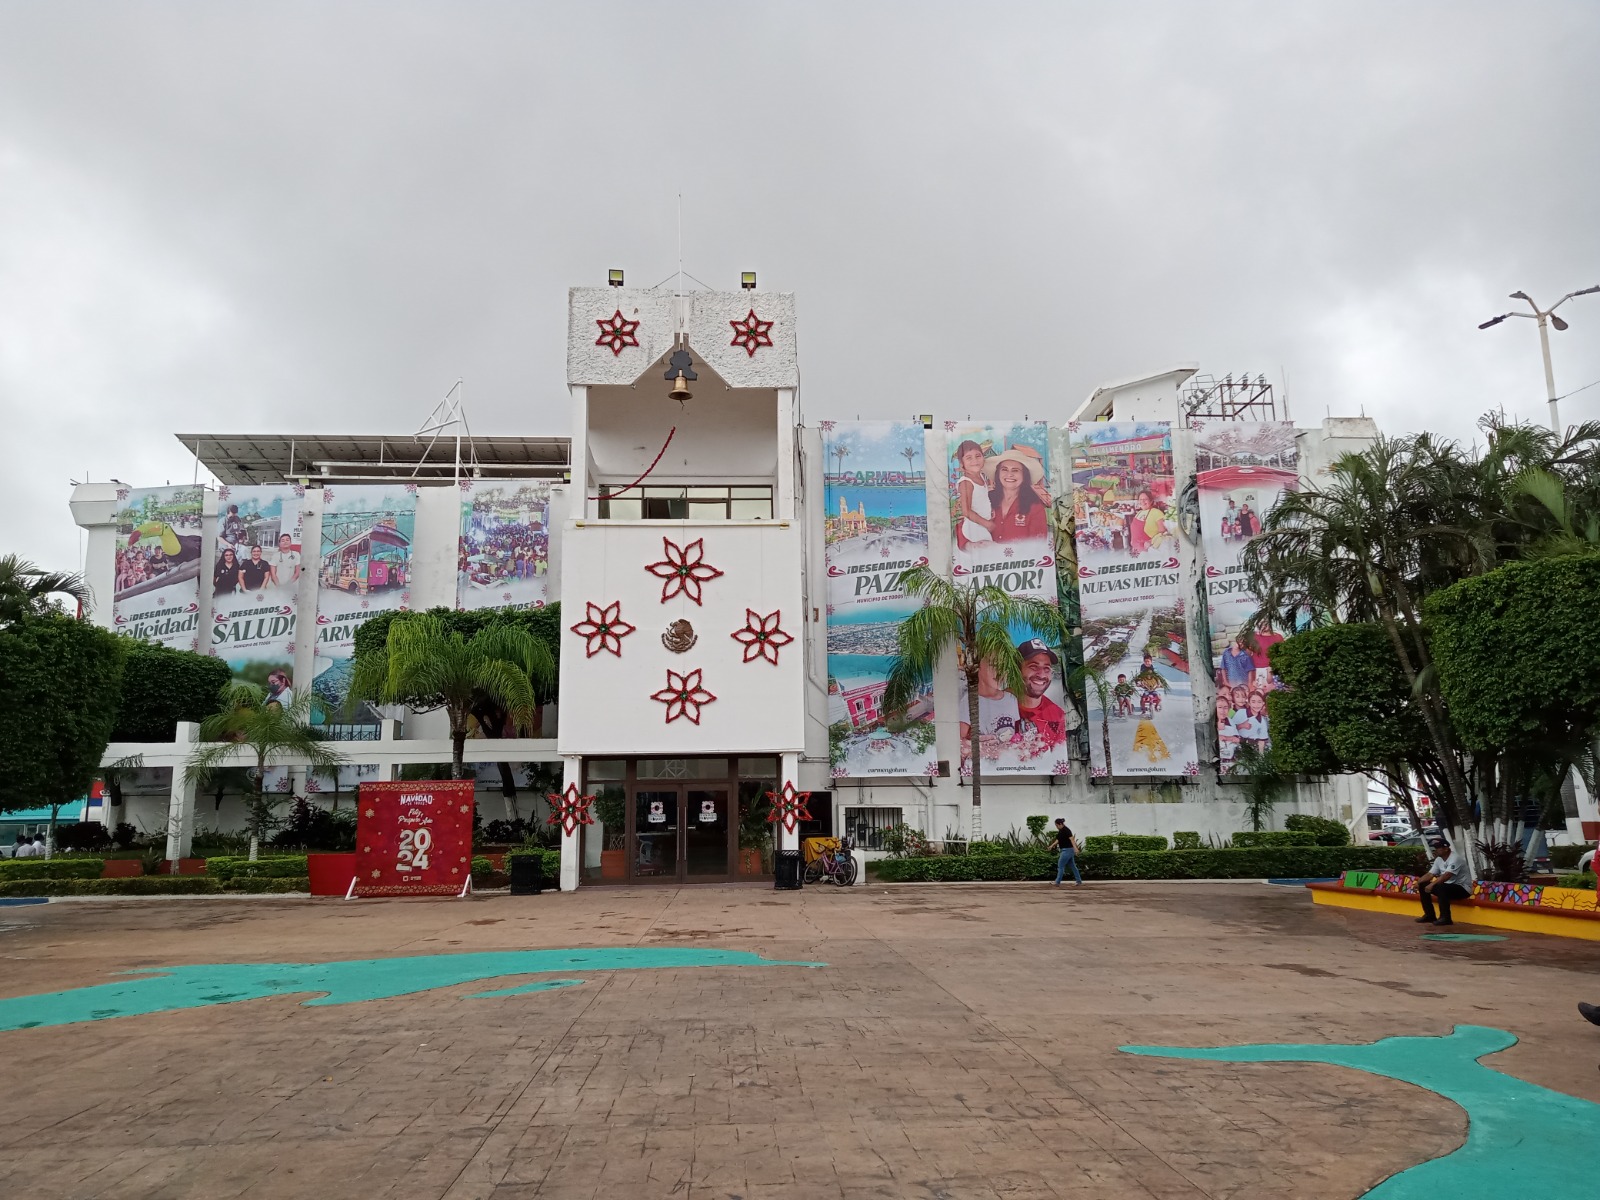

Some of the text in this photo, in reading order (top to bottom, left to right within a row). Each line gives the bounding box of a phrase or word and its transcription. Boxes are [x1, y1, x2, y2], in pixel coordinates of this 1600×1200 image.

[842, 471, 907, 485] CARMEN
[846, 559, 912, 575] ¡DESEAMOS
[971, 559, 1036, 574] ¡DESEAMOS
[1097, 560, 1162, 575] ¡DESEAMOS
[969, 568, 1044, 595] AMOR!
[1081, 573, 1180, 594] NUEVAS METAS!
[129, 606, 184, 621] ¡DESEAMOS
[228, 606, 281, 618] ¡DESEAMOS
[211, 614, 297, 645] SALUD!
[316, 624, 359, 644] ARM
[399, 828, 431, 850] 20
[396, 848, 429, 871] 24
